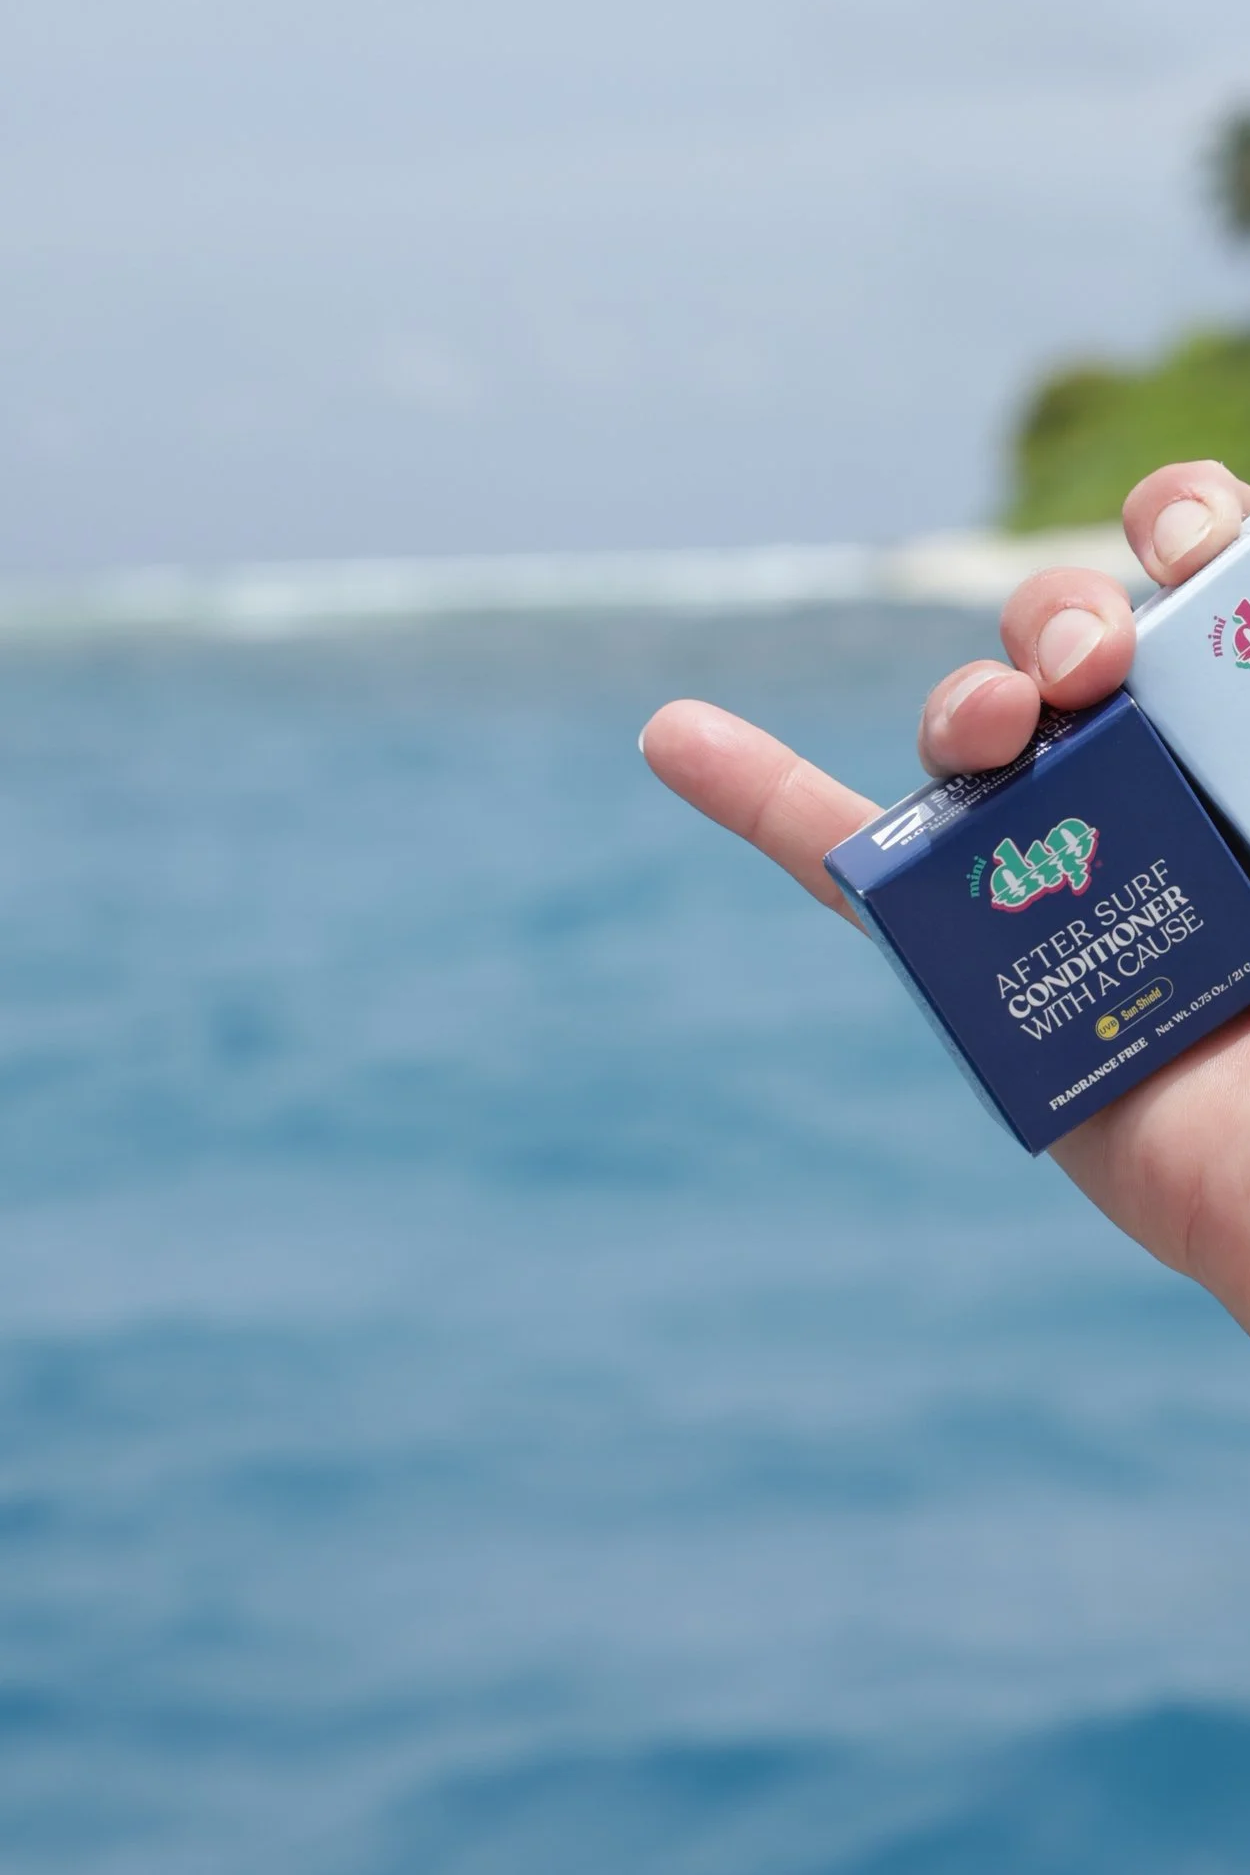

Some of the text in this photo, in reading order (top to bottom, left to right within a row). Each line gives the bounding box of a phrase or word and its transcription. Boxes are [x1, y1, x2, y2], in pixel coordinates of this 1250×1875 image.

[1208, 615, 1227, 657] mini
[966, 855, 987, 898] mini
[990, 818, 1100, 913] dip
[996, 859, 1169, 999] AFTER SURF
[1008, 886, 1190, 1018] CONDITIONER
[1020, 906, 1204, 1041] WITH A CAUSE
[1155, 1021, 1174, 1037] Net
[1172, 1010, 1192, 1024] Wt.
[1190, 992, 1212, 1012] 0.75
[1211, 982, 1229, 997] Oz.
[1232, 969, 1245, 980] 21
[1099, 987, 1162, 1035] UVB Sun Shield
[1049, 1037, 1149, 1111] FRAGRANCE FREE
